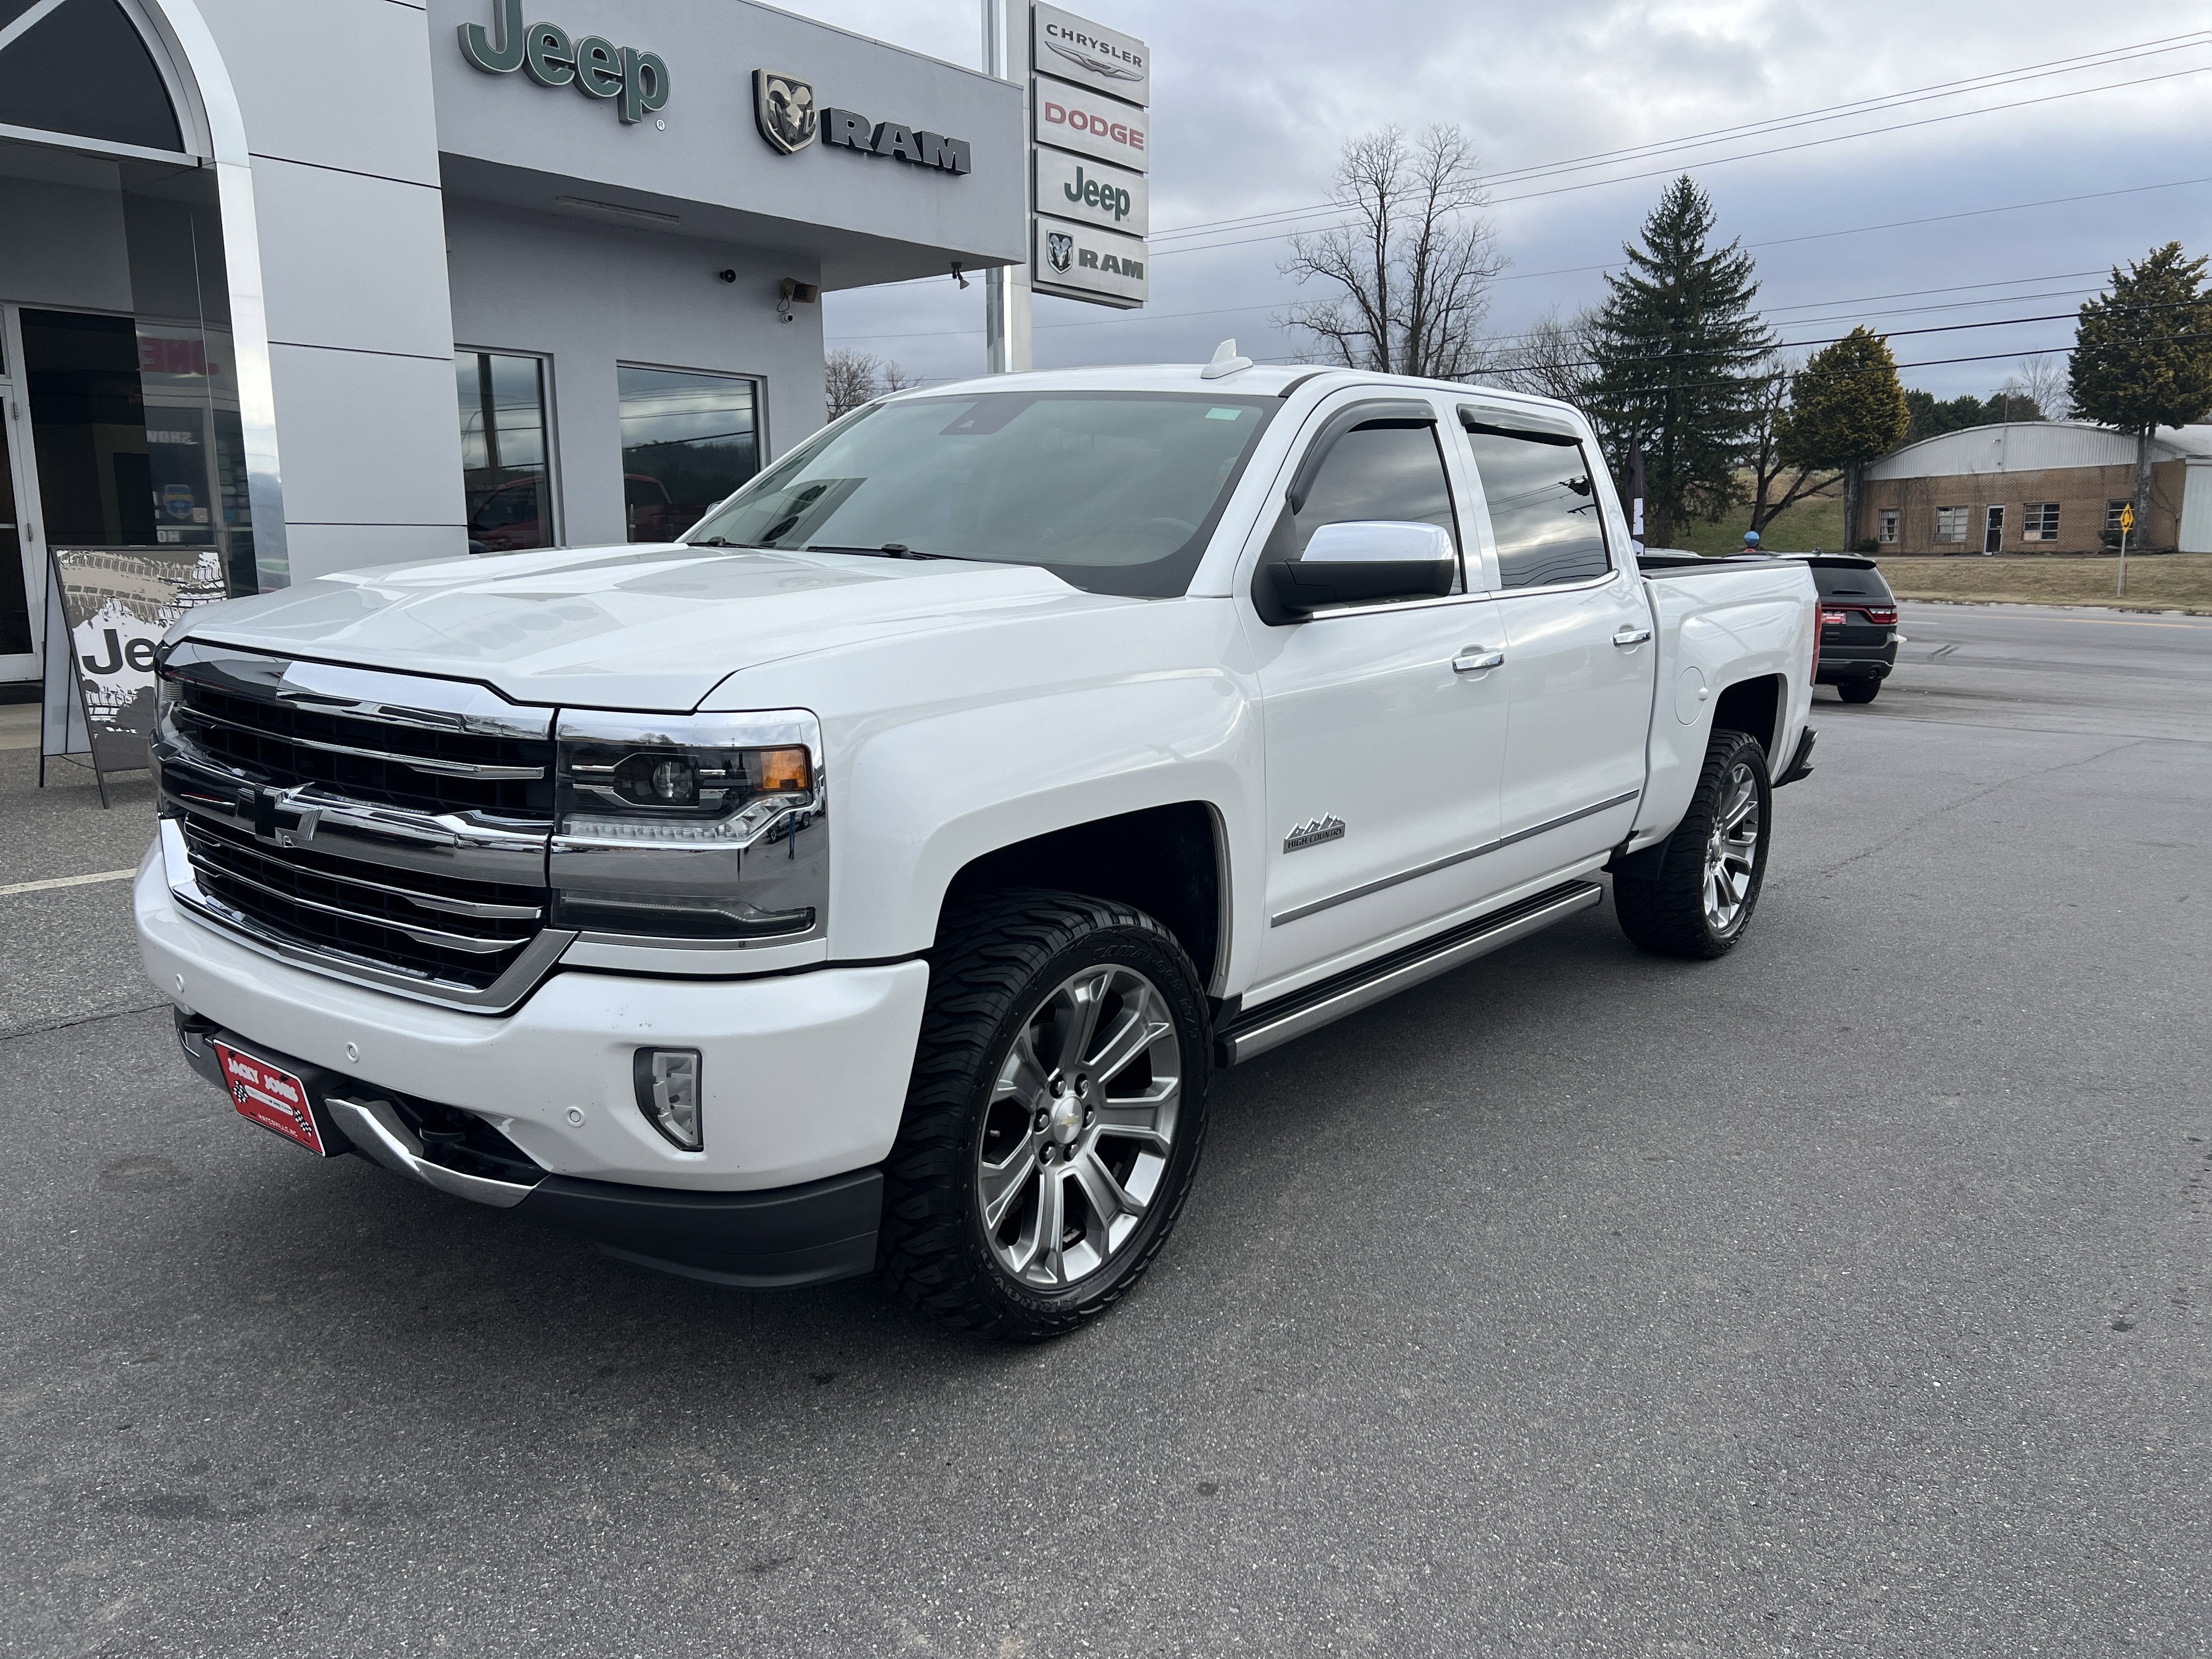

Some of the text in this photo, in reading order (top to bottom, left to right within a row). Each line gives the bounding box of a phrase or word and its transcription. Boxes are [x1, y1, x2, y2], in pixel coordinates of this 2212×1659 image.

[457, 0, 670, 125] Jeep
[1046, 24, 1142, 67] CHRYSLER
[821, 107, 971, 176] RAM
[1045, 101, 1144, 151] DODGE
[1064, 166, 1131, 222] Jeep
[1079, 248, 1144, 280] RAM
[81, 629, 155, 675] Je
[1287, 827, 1343, 849] HIGH COUNTRY
[264, 1074, 299, 1103] JONES
